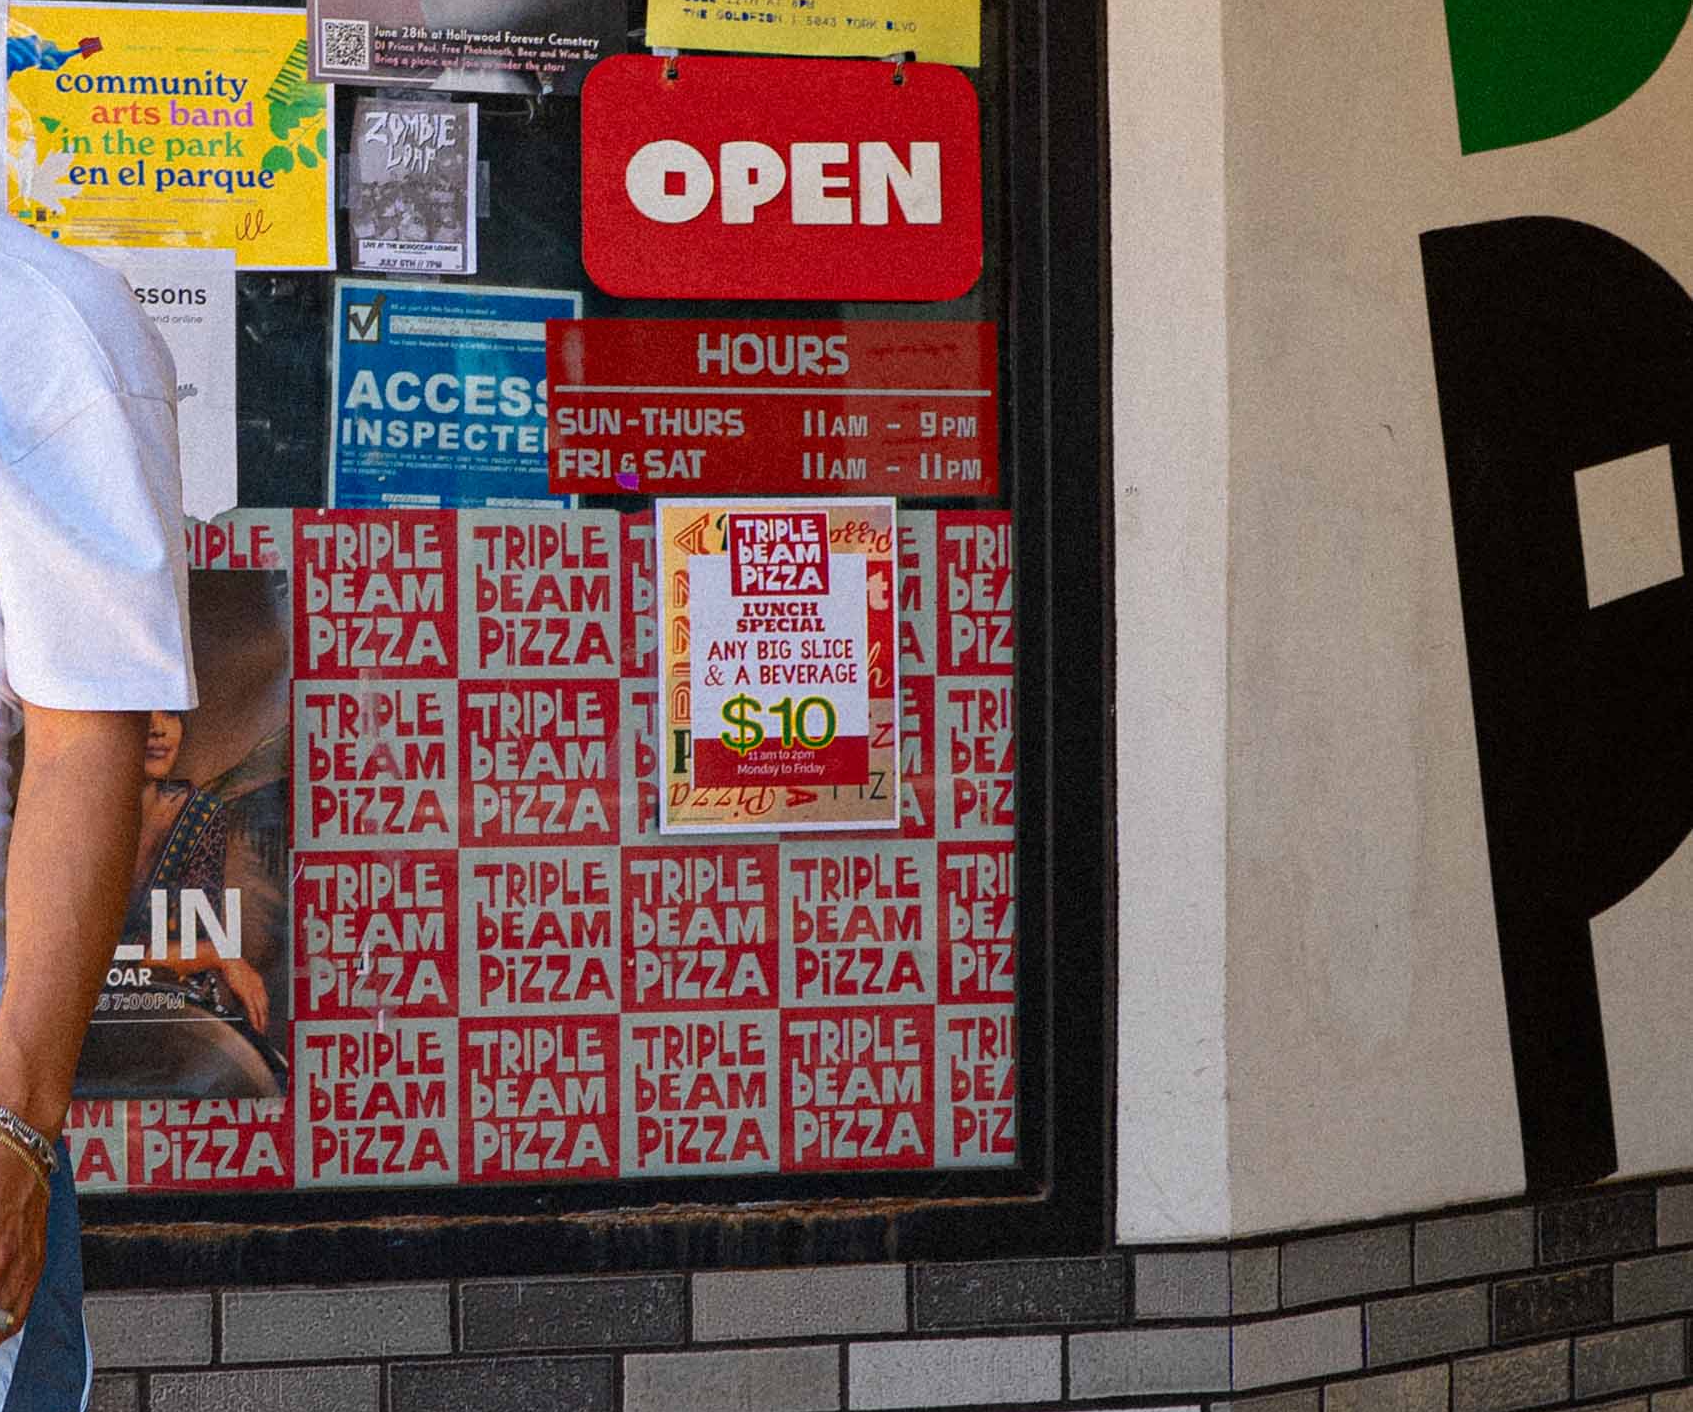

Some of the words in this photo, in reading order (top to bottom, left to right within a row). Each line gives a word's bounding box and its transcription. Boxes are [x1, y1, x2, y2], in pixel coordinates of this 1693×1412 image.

[374, 26, 397, 38] June
[402, 27, 427, 39] 28th
[431, 30, 442, 39] at
[446, 29, 501, 43] Hollywood
[505, 30, 544, 45] Forever
[548, 33, 600, 49] Cemetery
[442, 44, 460, 54] Free
[517, 47, 537, 57] Beer
[539, 49, 557, 58] and
[559, 50, 580, 59] Wine
[583, 50, 599, 60] Bar
[56, 70, 248, 102] community
[91, 100, 161, 125] arts
[170, 100, 254, 127] band
[365, 112, 456, 149] ZOMBIE
[61, 128, 92, 155] in
[102, 129, 154, 155] the
[166, 131, 245, 162] park
[69, 165, 109, 185] en
[118, 160, 145, 186] el
[155, 167, 275, 194] parque
[625, 139, 942, 226] OPEN
[697, 333, 850, 377] HOURS
[342, 418, 548, 453] INSPECTE
[919, 412, 978, 438] 9PM
[558, 449, 611, 478] FRI
[619, 451, 638, 476] &
[643, 449, 706, 478] SAT
[742, 602, 818, 617] LUNCH
[736, 618, 825, 633] SPECIAL
[708, 640, 748, 661] ANY
[757, 640, 792, 660] BIG
[801, 639, 853, 659] SLICE
[705, 664, 724, 686] &
[734, 666, 751, 686] A
[760, 664, 857, 685] BEVERAGE
[721, 693, 837, 756] $10
[792, 750, 815, 762] 2pm
[737, 764, 779, 777] Monday
[782, 764, 793, 774] to
[794, 763, 826, 776] Friday
[114, 888, 241, 960] IN
[113, 992, 185, 1010] 7:00PM
